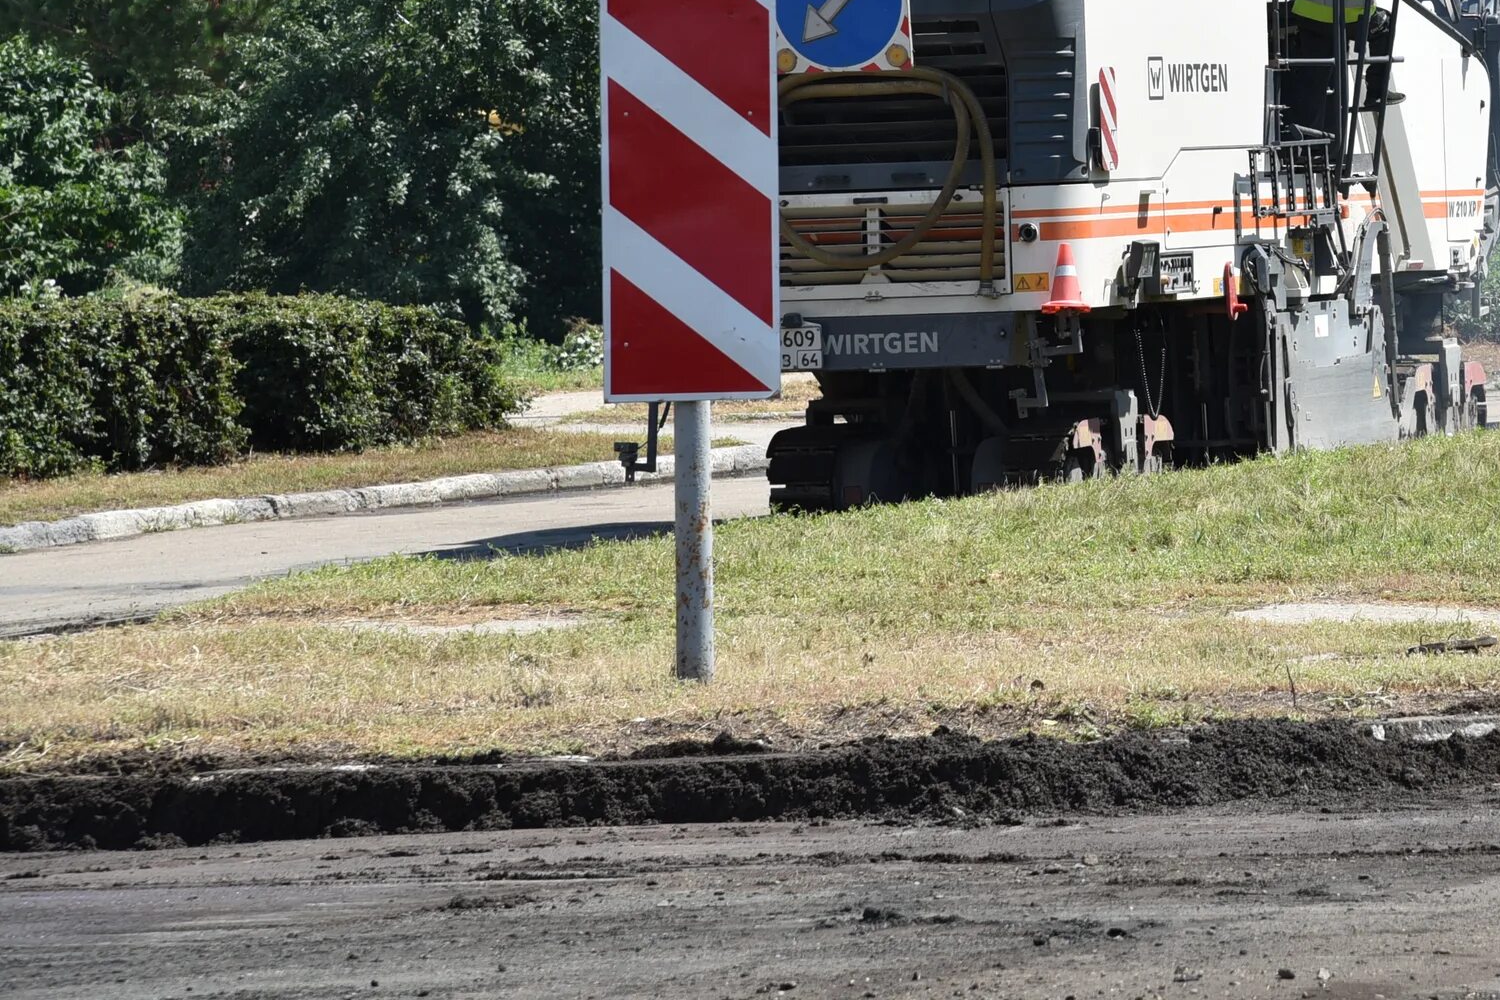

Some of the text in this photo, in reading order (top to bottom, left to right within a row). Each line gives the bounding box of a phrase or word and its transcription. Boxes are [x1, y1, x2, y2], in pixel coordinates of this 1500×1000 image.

[1168, 63, 1228, 92] WIRTGEN
[1449, 200, 1476, 218] W 210 XP
[781, 330, 815, 348] 609
[824, 332, 938, 355] WIRTGEN
[801, 353, 818, 367] 64
